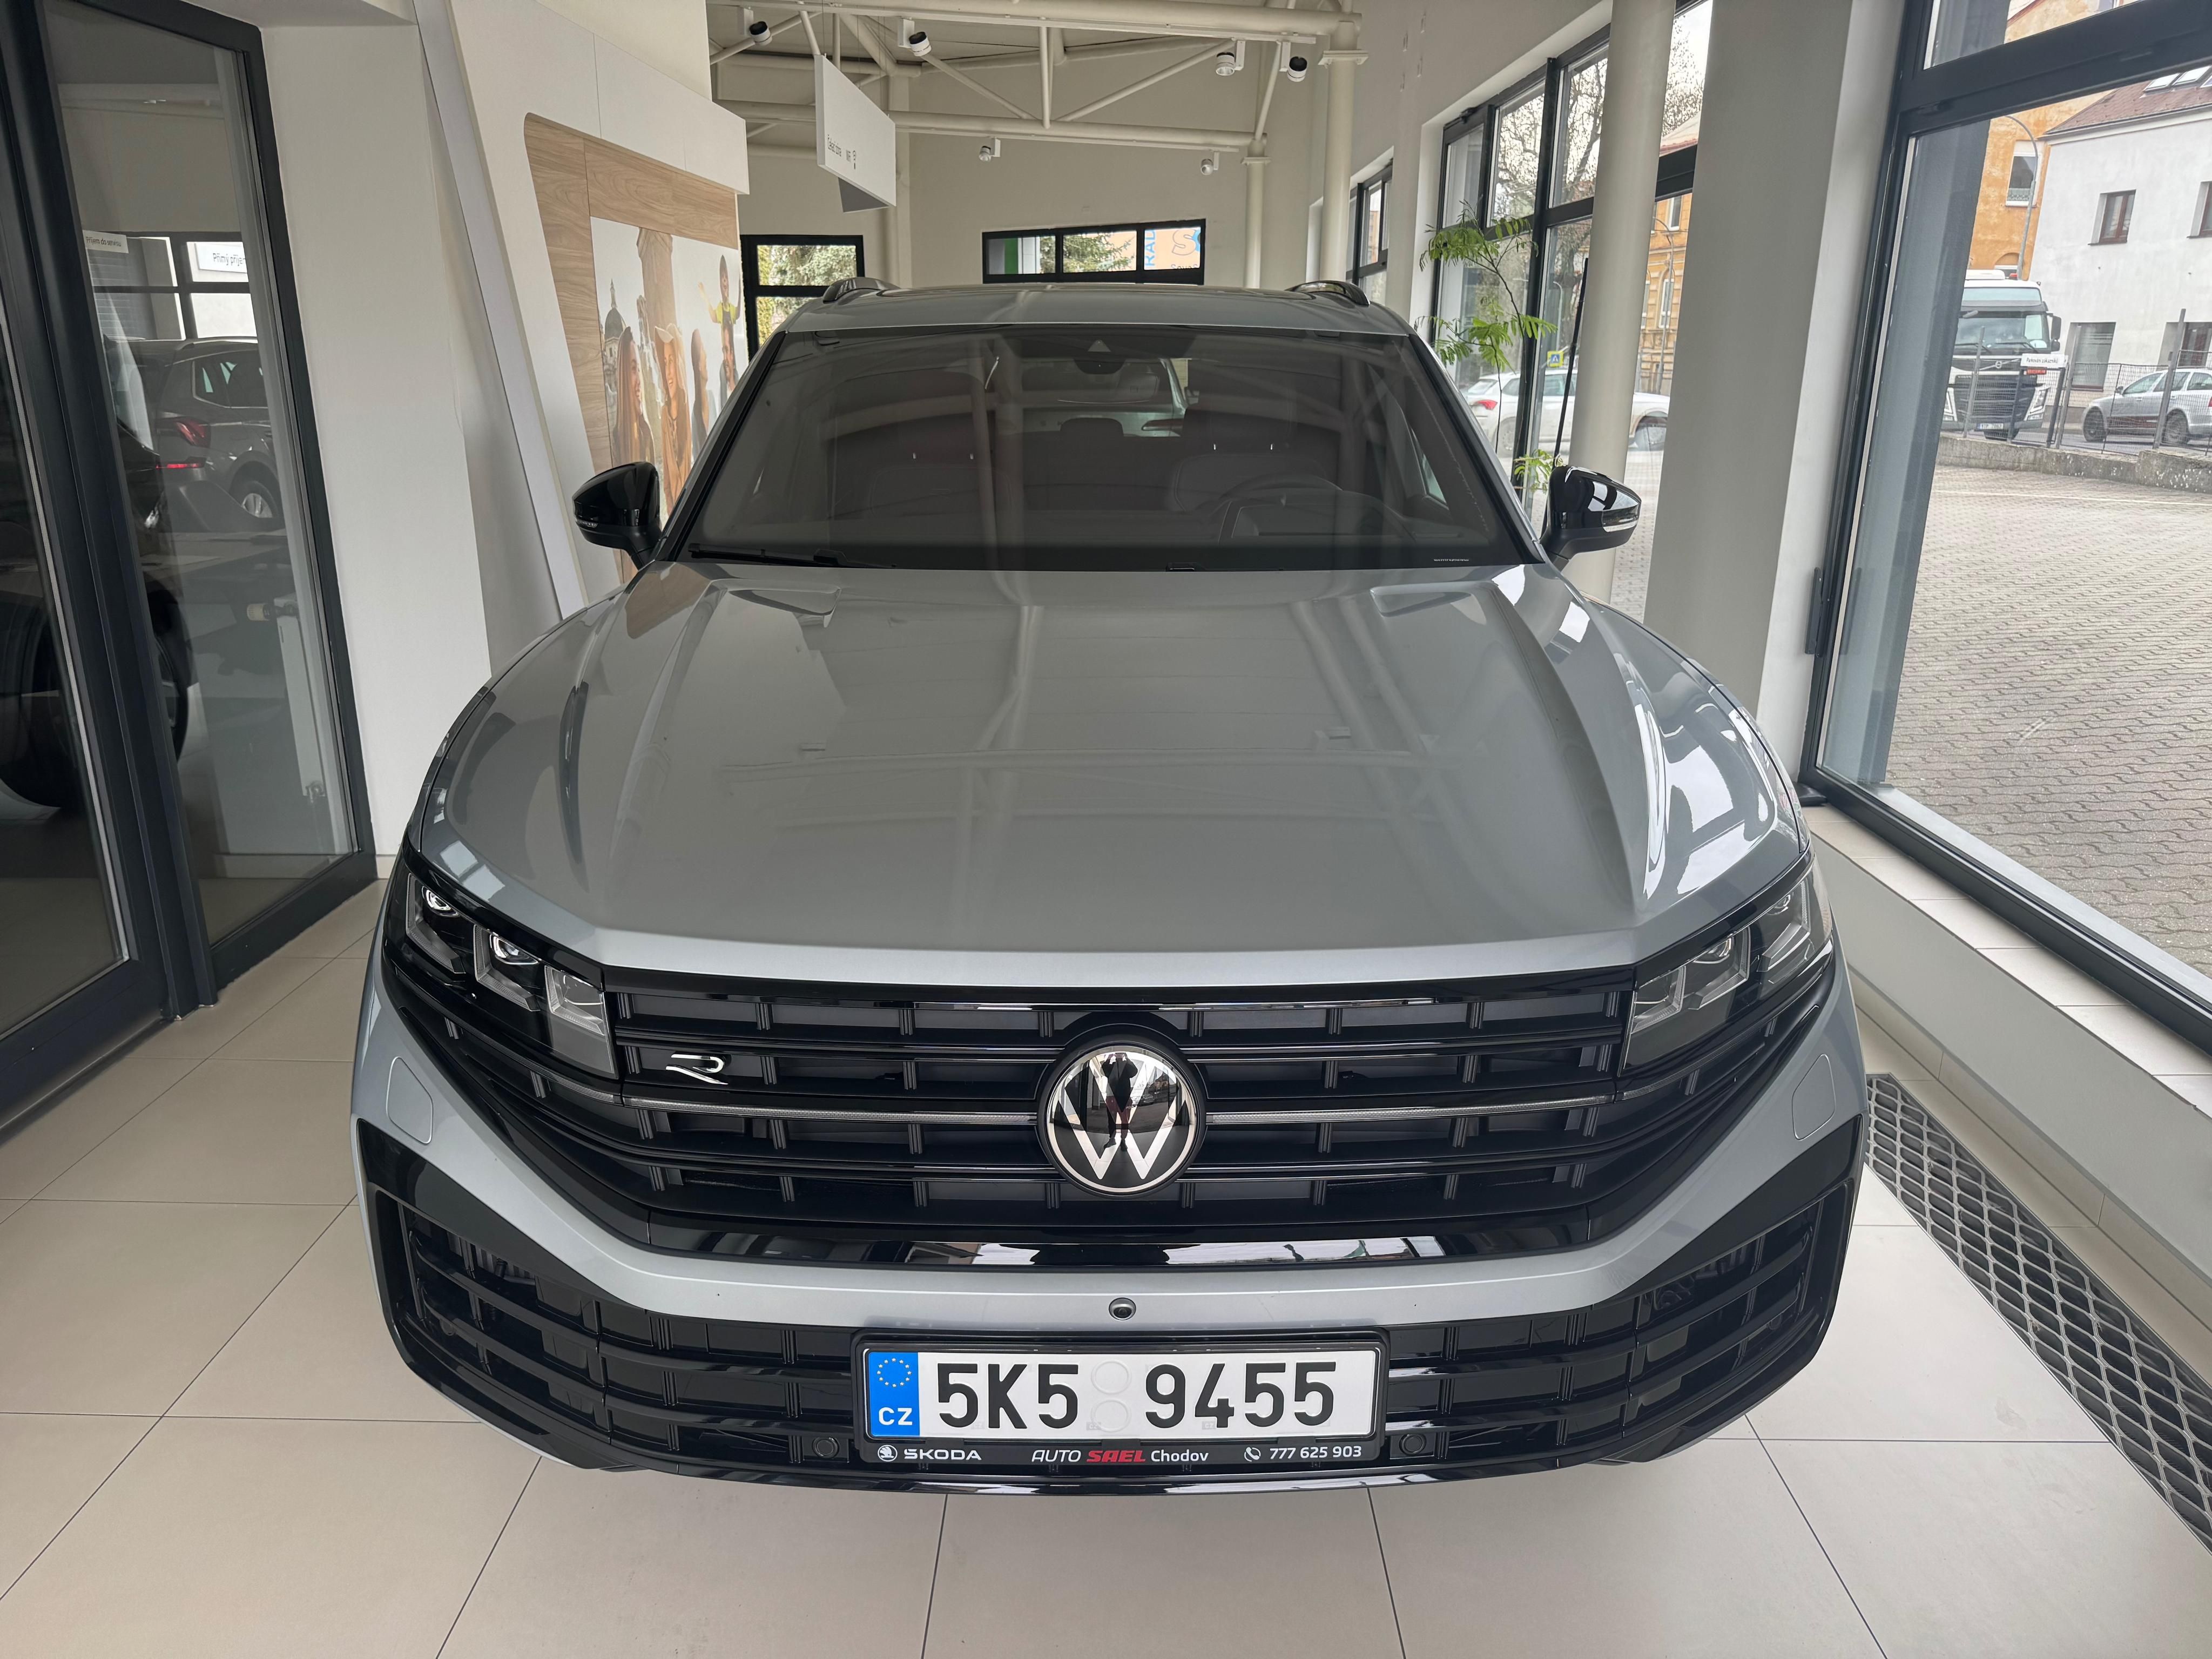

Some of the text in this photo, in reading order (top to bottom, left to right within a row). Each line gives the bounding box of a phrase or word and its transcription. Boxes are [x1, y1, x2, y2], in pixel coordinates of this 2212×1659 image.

[231, 254, 246, 266] příje
[878, 1361, 1337, 1429] CZ 5K5 9455
[1031, 1449, 1209, 1462] AUTO SAEL Chodov
[1270, 1446, 1362, 1459] 777 625 903
